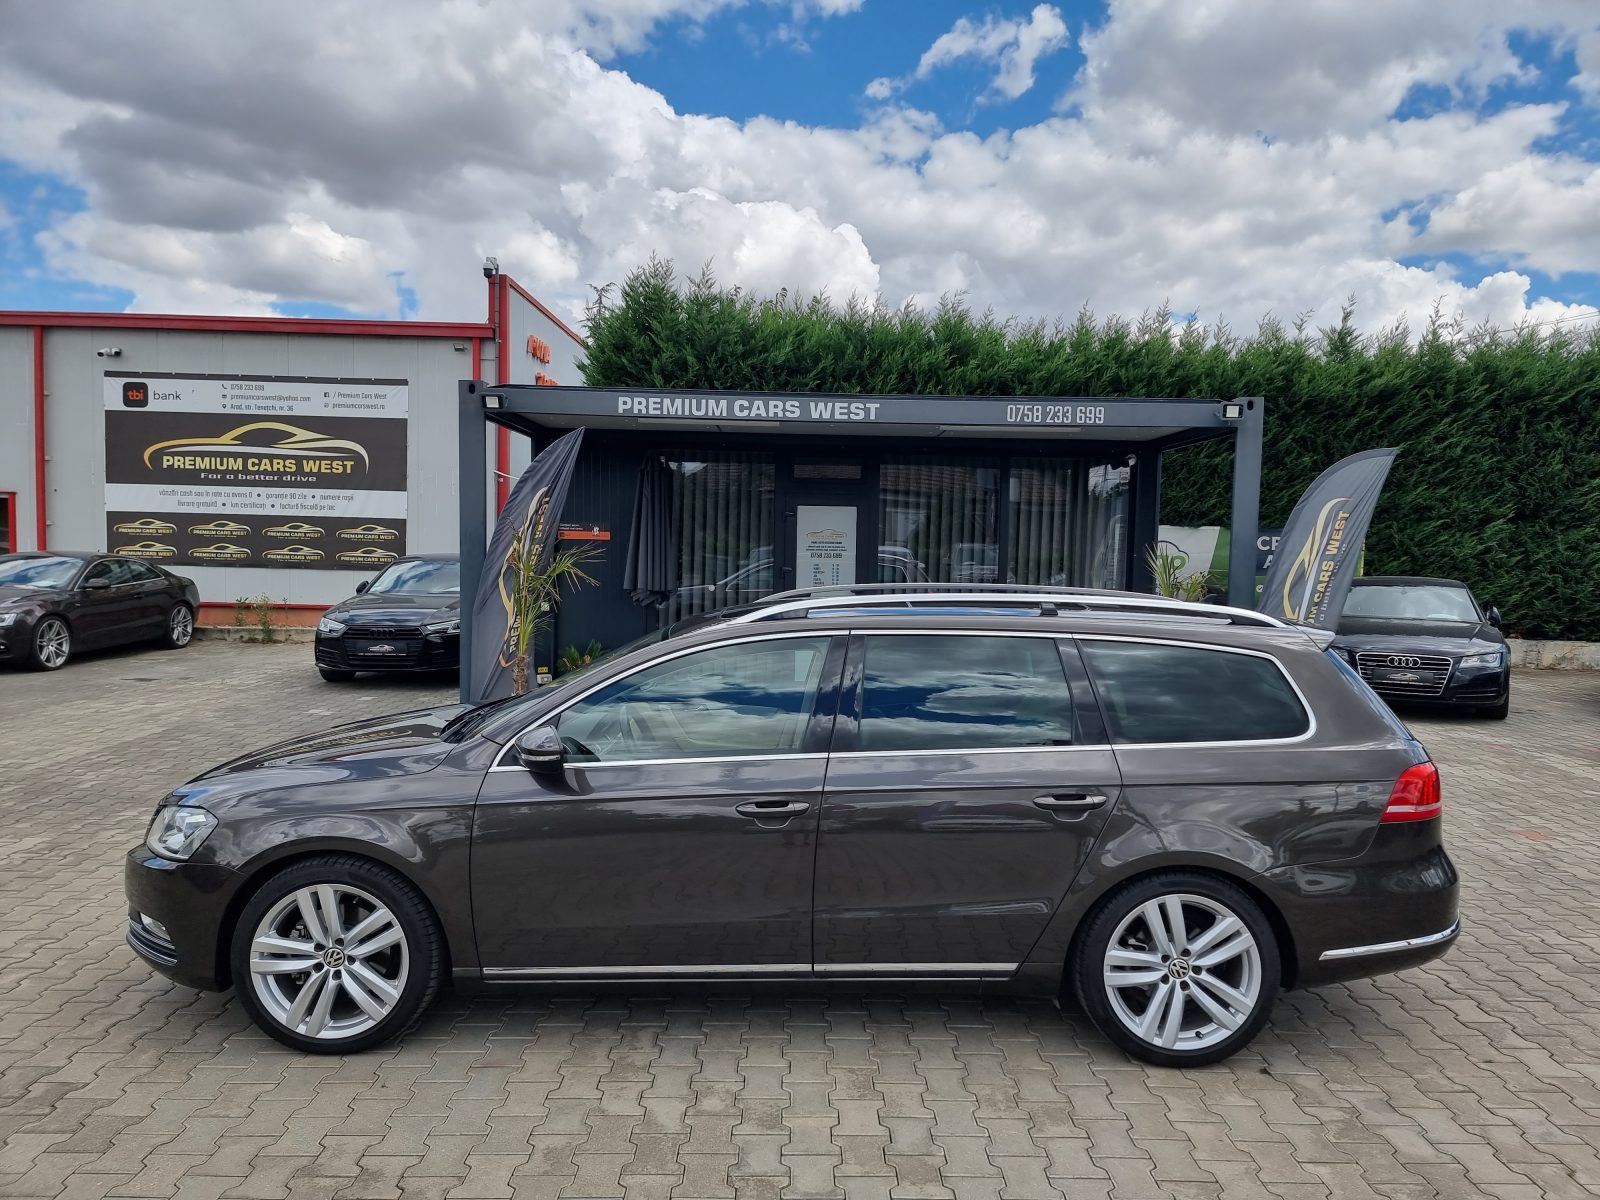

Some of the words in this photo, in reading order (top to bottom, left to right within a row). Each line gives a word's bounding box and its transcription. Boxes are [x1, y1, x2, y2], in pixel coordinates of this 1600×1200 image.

[127, 390, 145, 400] tbi
[153, 390, 182, 401] bank
[338, 391, 360, 399] Premium
[617, 396, 728, 417] PREMIUM
[733, 400, 800, 418] CARS
[810, 401, 880, 420] WEST
[1006, 404, 1042, 422] 0758
[1046, 406, 1072, 424] 233
[1076, 406, 1105, 424] 699
[162, 455, 243, 470] PREMIUM
[247, 458, 297, 472] CARS
[302, 460, 355, 474] WEST
[238, 473, 280, 481] better
[282, 474, 318, 482] drive
[1314, 560, 1335, 602] CARS
[1326, 510, 1350, 555] WEST
